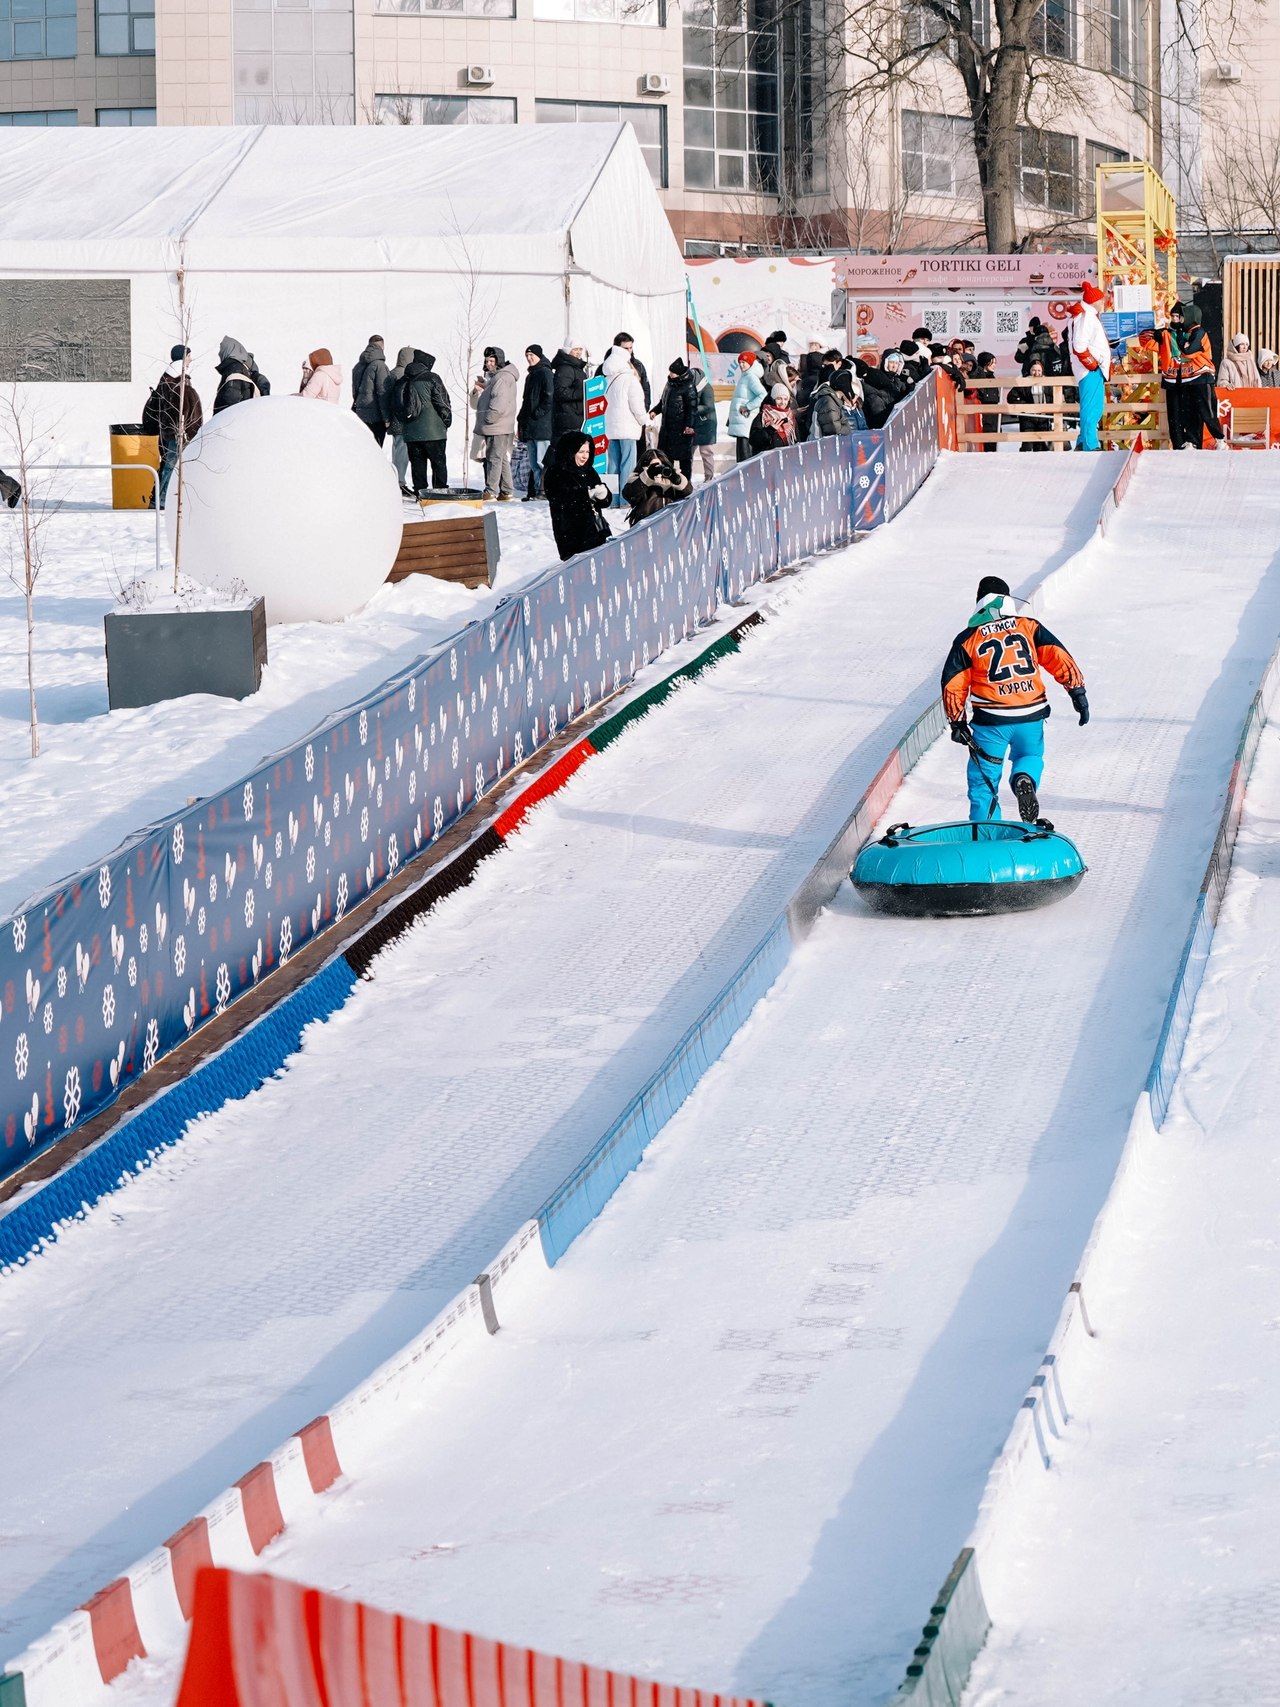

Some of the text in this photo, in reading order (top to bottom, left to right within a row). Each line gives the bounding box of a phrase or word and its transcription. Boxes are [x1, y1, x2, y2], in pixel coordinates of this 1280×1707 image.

[847, 268, 902, 276] МОРОЖЕНОЕ
[920, 260, 1022, 272] TORTIKI GELI
[1057, 271, 1086, 279] СОБОЙ
[977, 632, 1037, 683] 23
[998, 680, 1035, 696] КУРСК
